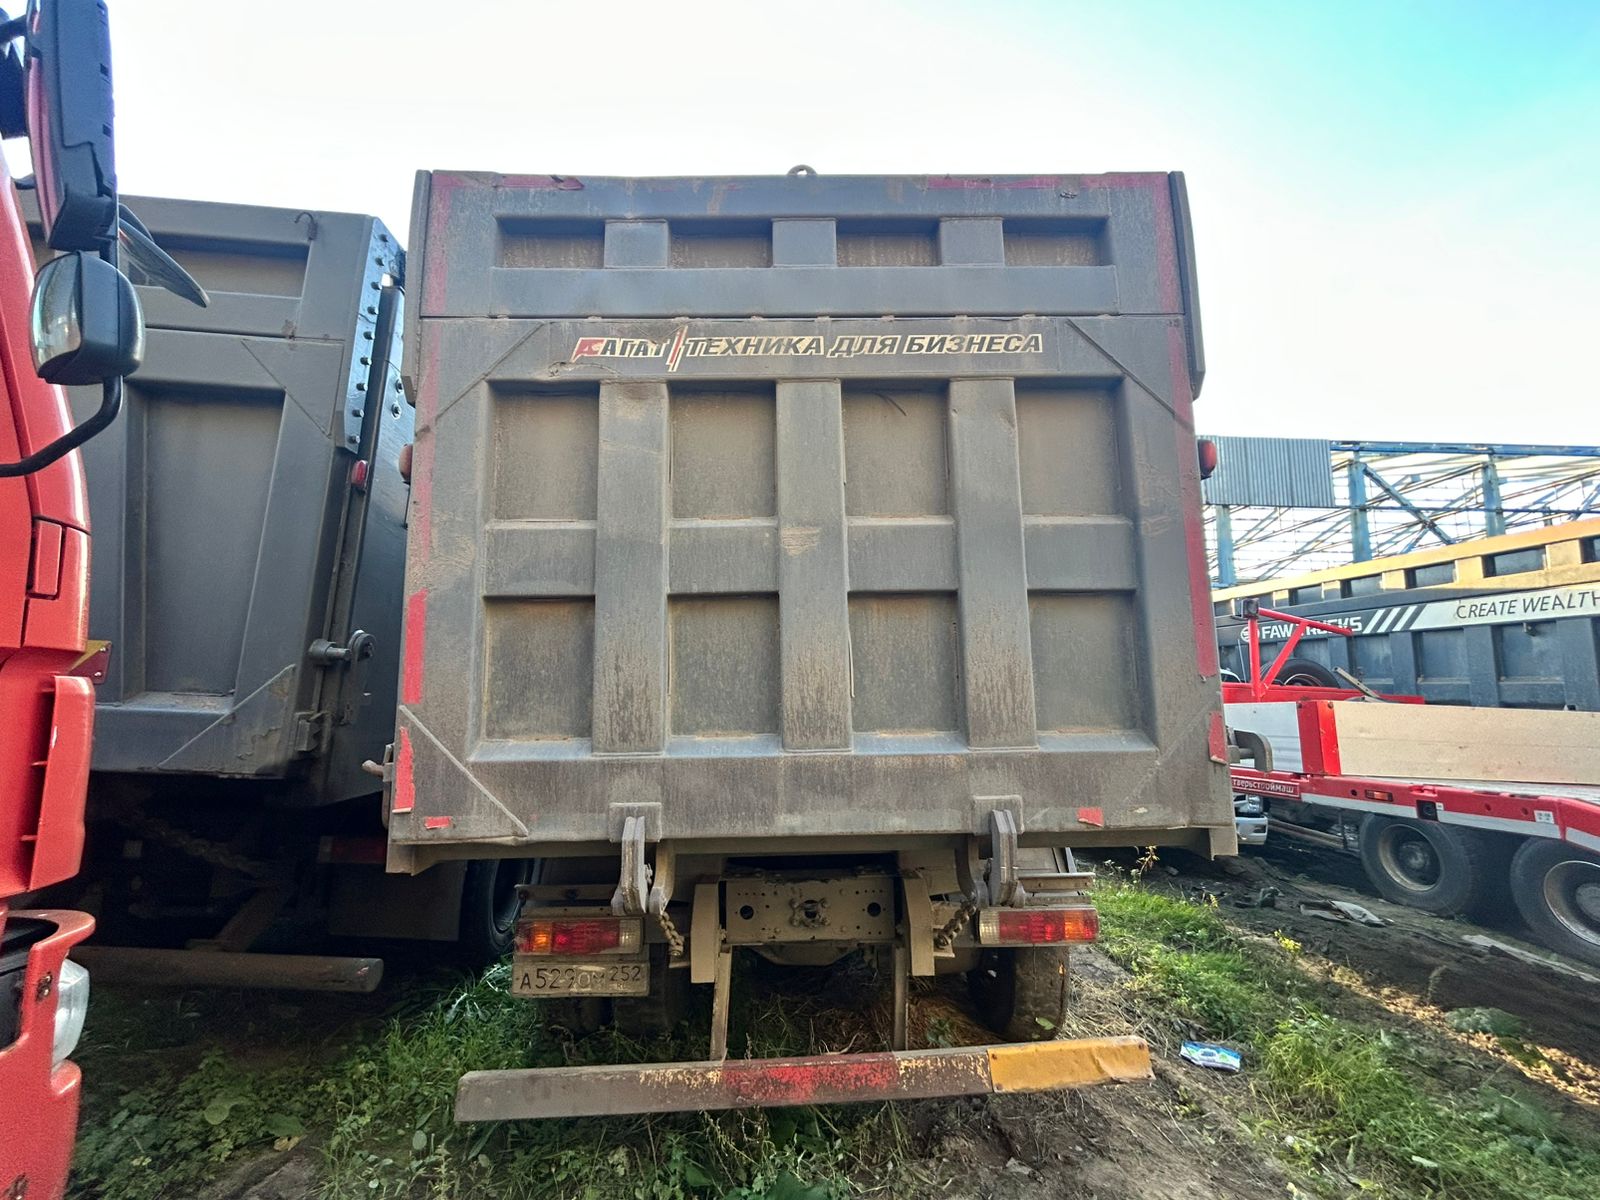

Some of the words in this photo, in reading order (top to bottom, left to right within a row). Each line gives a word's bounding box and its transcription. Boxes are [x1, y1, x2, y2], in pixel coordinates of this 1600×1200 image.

[600, 337, 671, 358] АГАТ
[686, 335, 824, 357] ТЕХНИКА
[827, 335, 901, 358] ДЛЯ
[902, 333, 1043, 354] БИЗНЕСА
[1456, 599, 1518, 619] CREATE
[1261, 623, 1294, 639] FAW
[610, 965, 641, 982] 252
